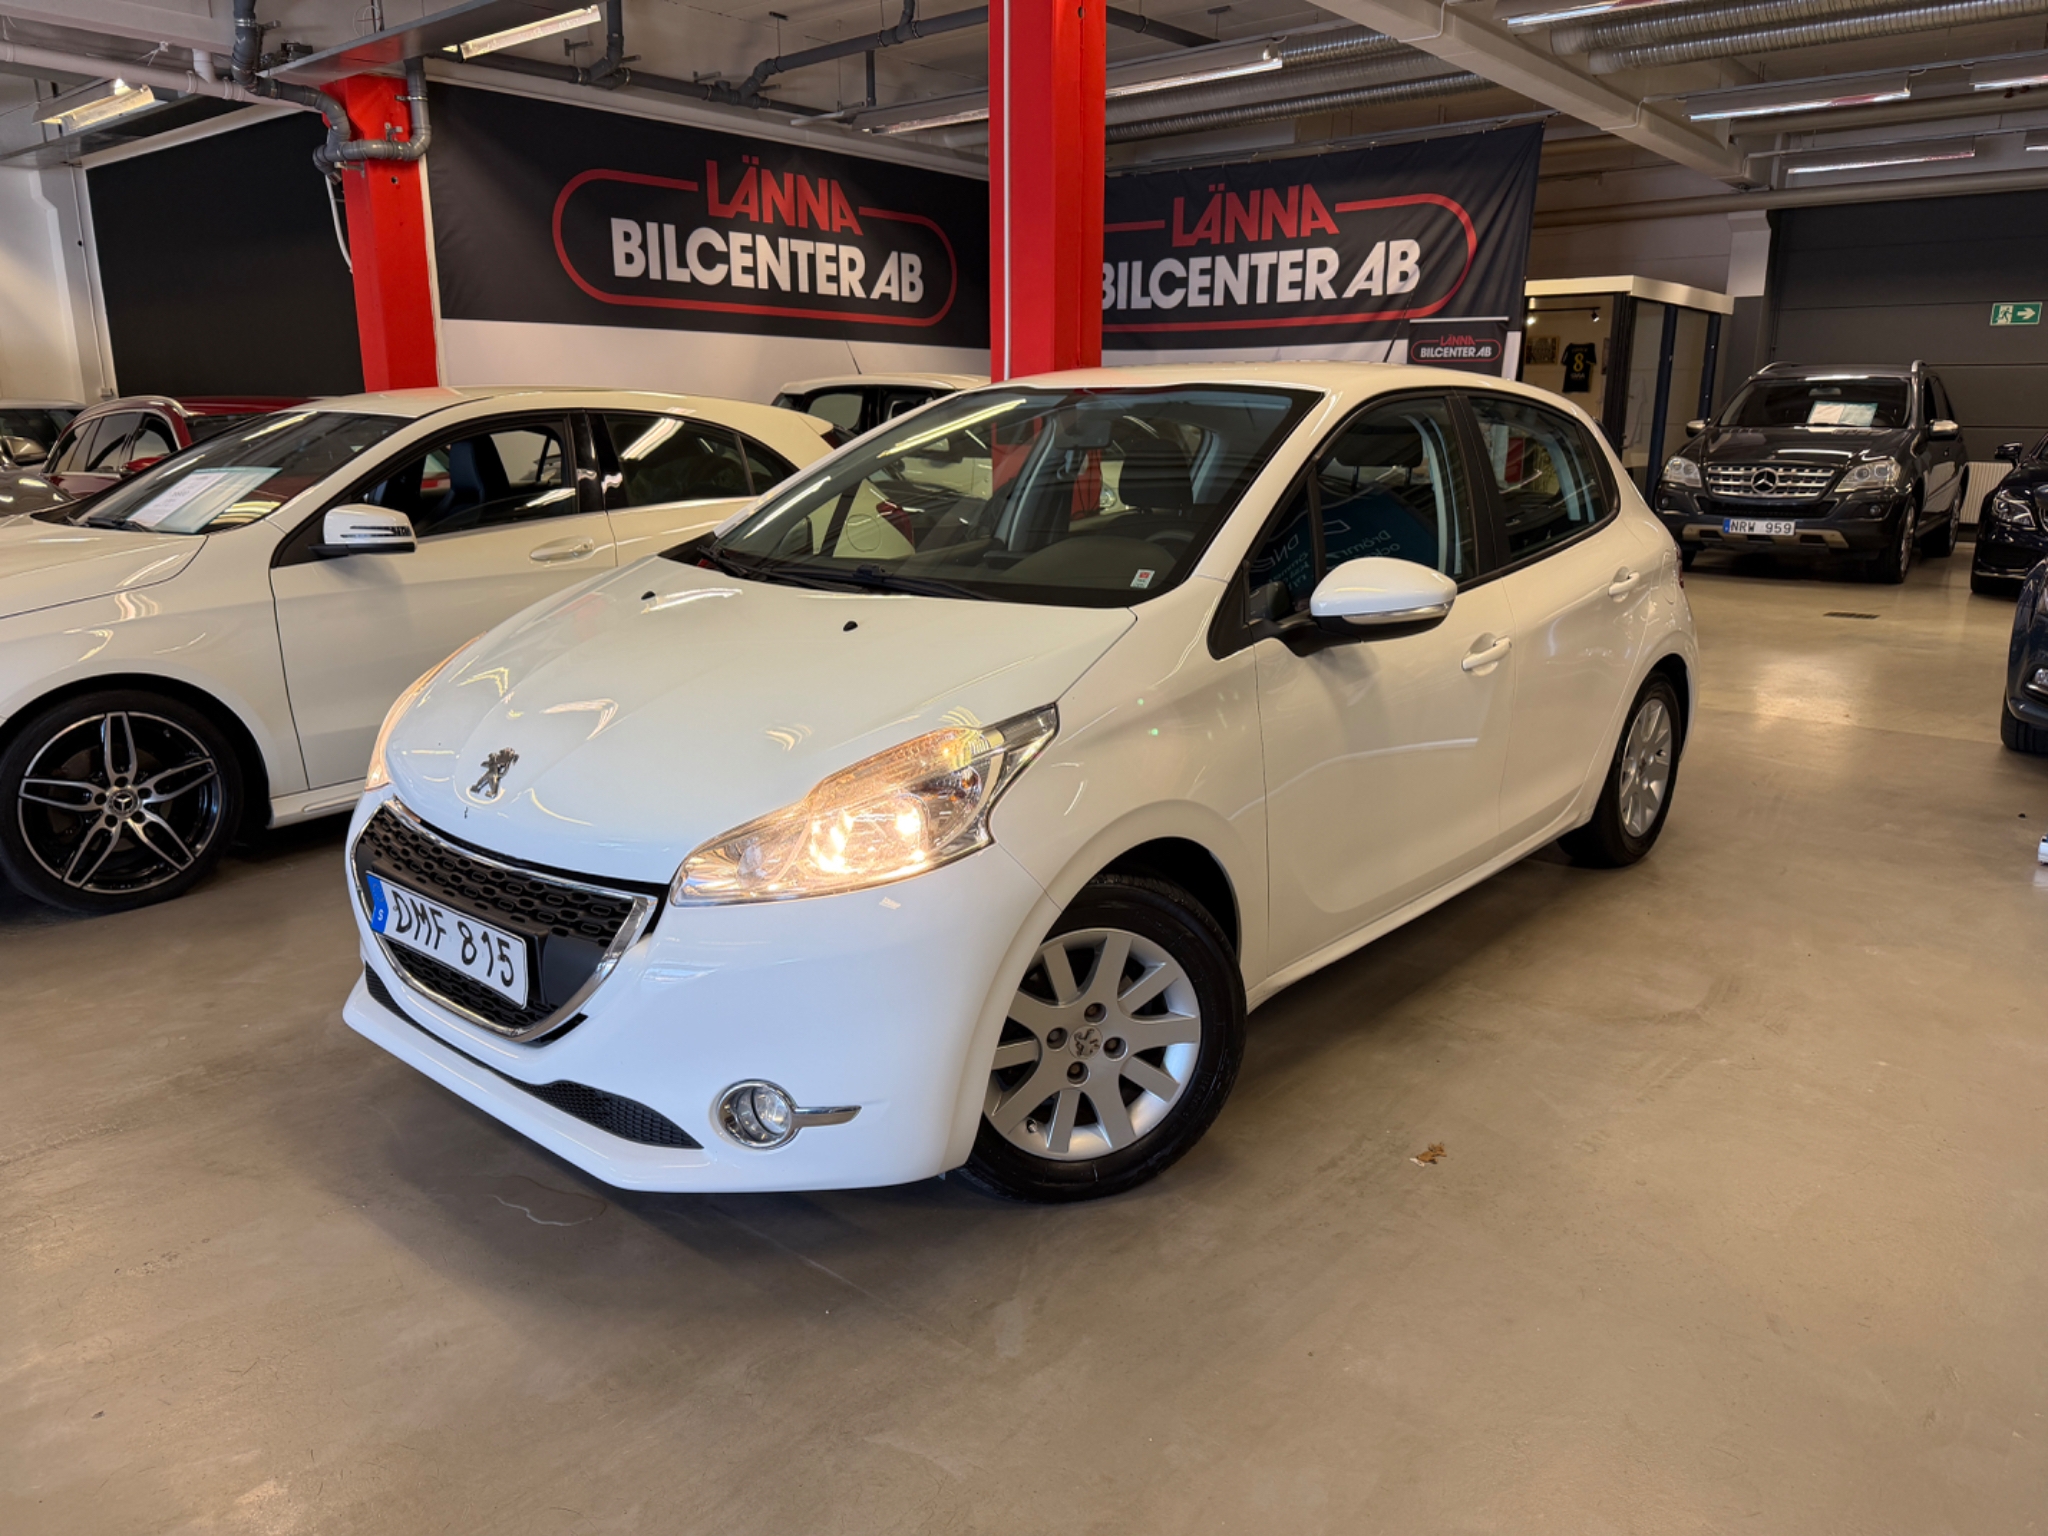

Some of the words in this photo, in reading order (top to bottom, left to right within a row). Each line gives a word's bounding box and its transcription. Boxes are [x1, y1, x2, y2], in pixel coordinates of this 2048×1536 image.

[706, 155, 864, 236] LÄNNA
[1171, 183, 1340, 247] LÄNNA
[610, 217, 867, 299] BILCENTER
[869, 251, 925, 303] AB
[1341, 238, 1421, 299] AB
[1420, 346, 1476, 358] BILCENTER
[1475, 346, 1492, 358] AB
[1573, 352, 1584, 372] 8
[1730, 520, 1756, 532] NRW
[1765, 522, 1792, 534] 959
[377, 908, 385, 921] S
[391, 890, 447, 950] DMF
[457, 921, 514, 987] 815
